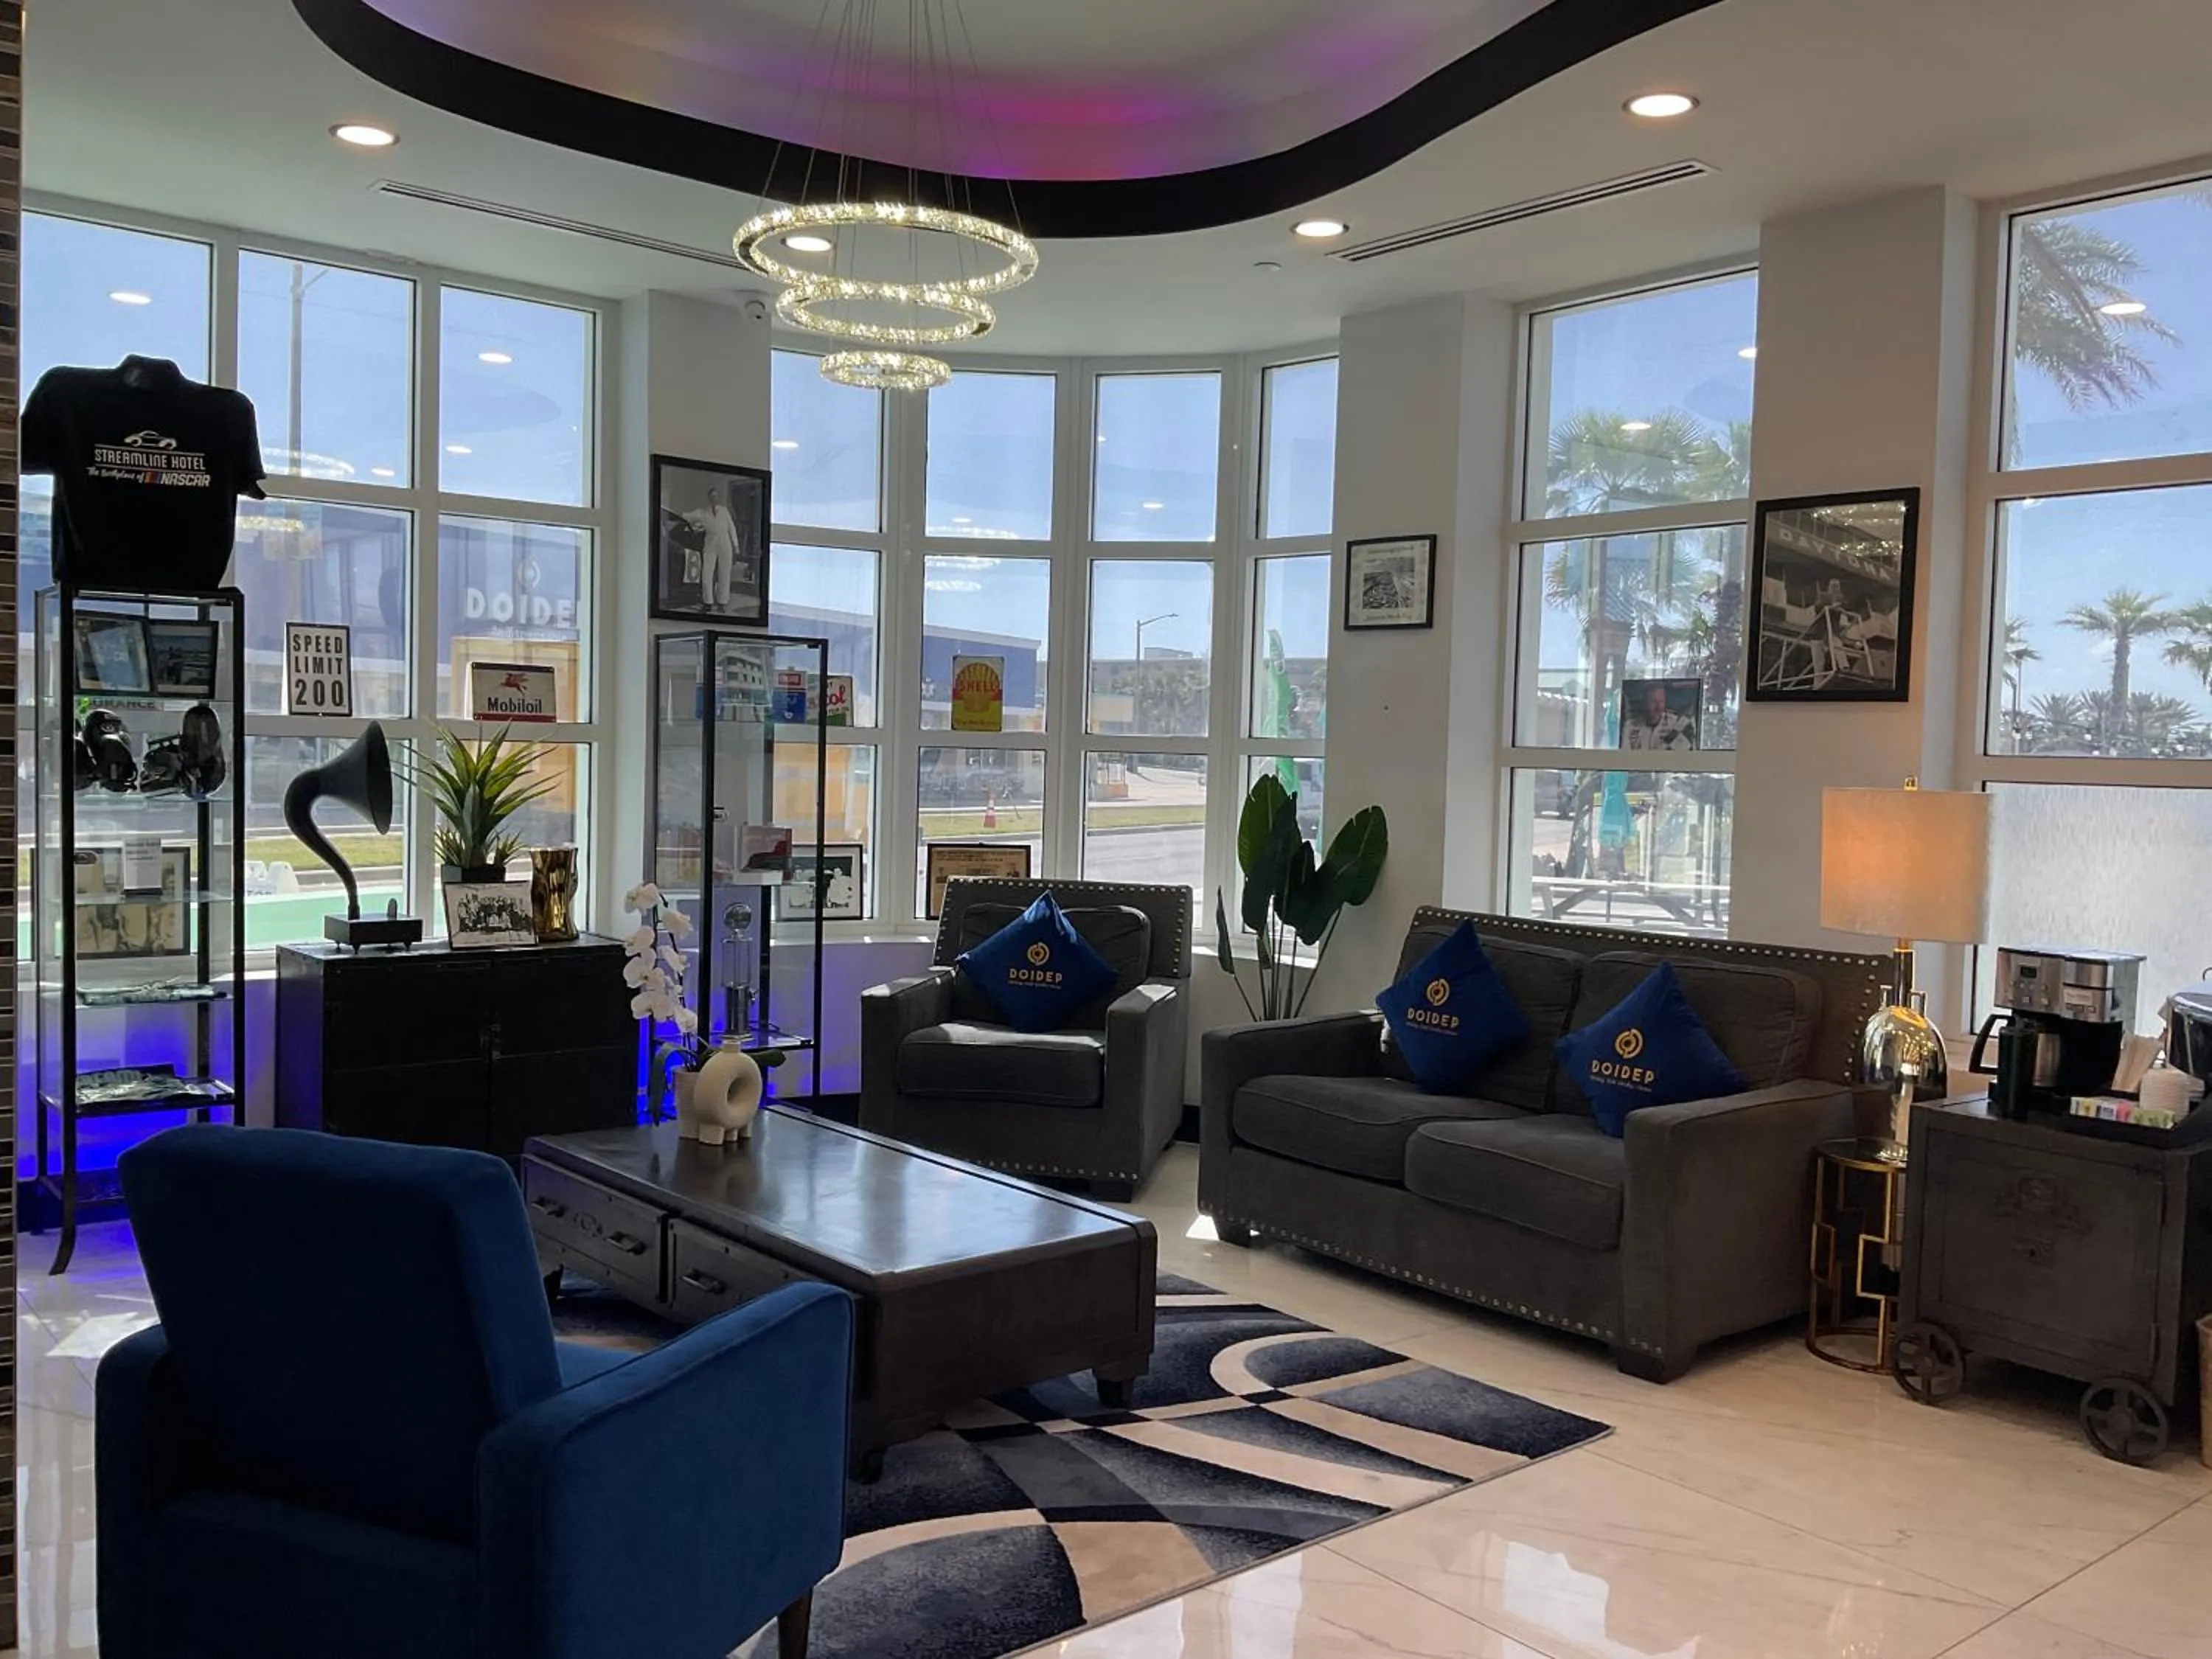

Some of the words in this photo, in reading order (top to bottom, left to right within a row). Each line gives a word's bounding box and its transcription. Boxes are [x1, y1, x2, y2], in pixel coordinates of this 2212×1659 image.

[94, 448, 167, 467] STREAMLINE
[171, 456, 206, 470] HOTEL
[160, 473, 211, 487] NASCAR
[1778, 527, 1893, 582] DAYTONA
[293, 633, 343, 655] SPEED
[294, 655, 343, 675] LIMIT
[295, 679, 344, 707] 200
[959, 681, 998, 692] SHELL
[487, 696, 543, 714] Mobiloil
